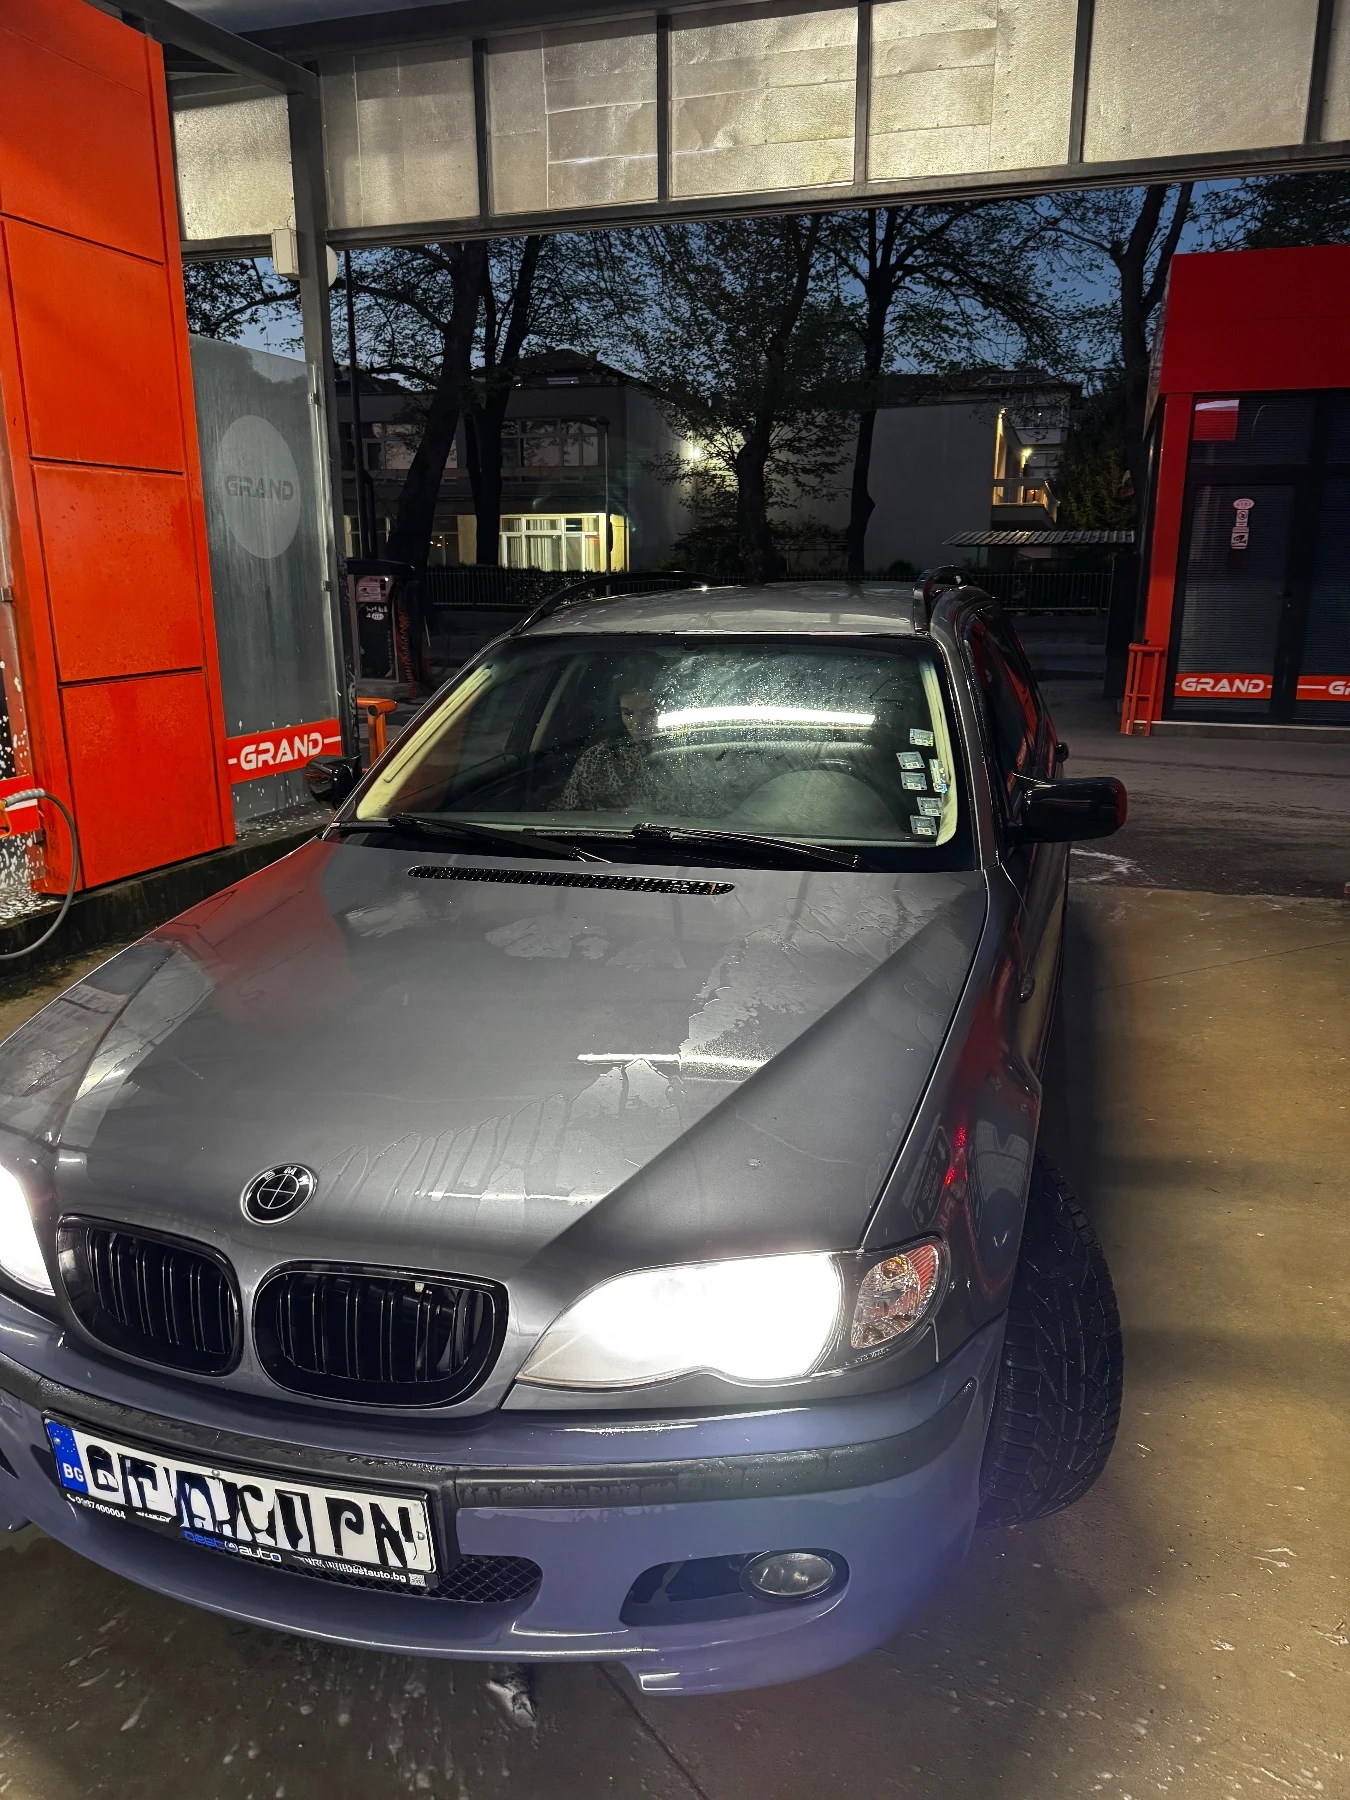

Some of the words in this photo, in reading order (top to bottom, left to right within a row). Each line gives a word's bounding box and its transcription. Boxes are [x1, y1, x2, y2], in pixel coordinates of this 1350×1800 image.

[225, 476, 295, 500] GRAND
[1181, 678, 1265, 693] GRAND
[240, 732, 323, 771] GRAND
[62, 1462, 84, 1483] BG
